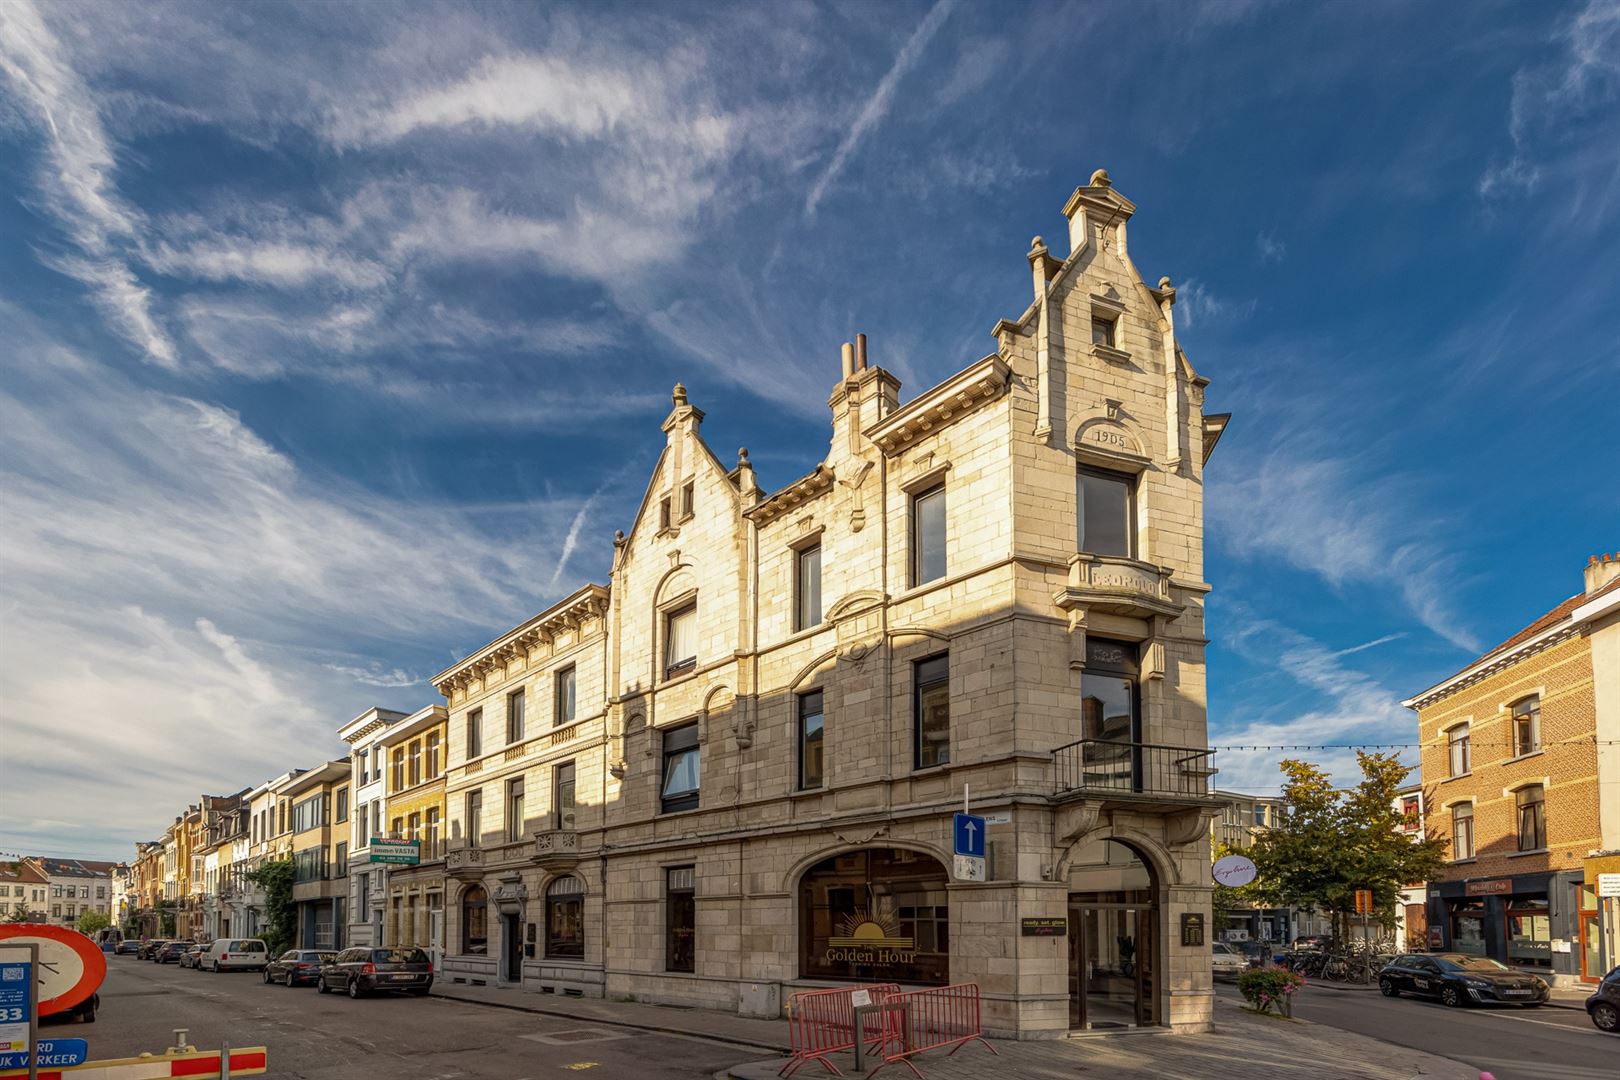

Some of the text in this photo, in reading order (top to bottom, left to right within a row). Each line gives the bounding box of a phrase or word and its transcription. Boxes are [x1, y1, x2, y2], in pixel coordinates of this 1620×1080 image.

[1095, 431, 1126, 448] 1905
[826, 948, 917, 963] Golden Hour
[20, 1054, 78, 1066] VRKEER
